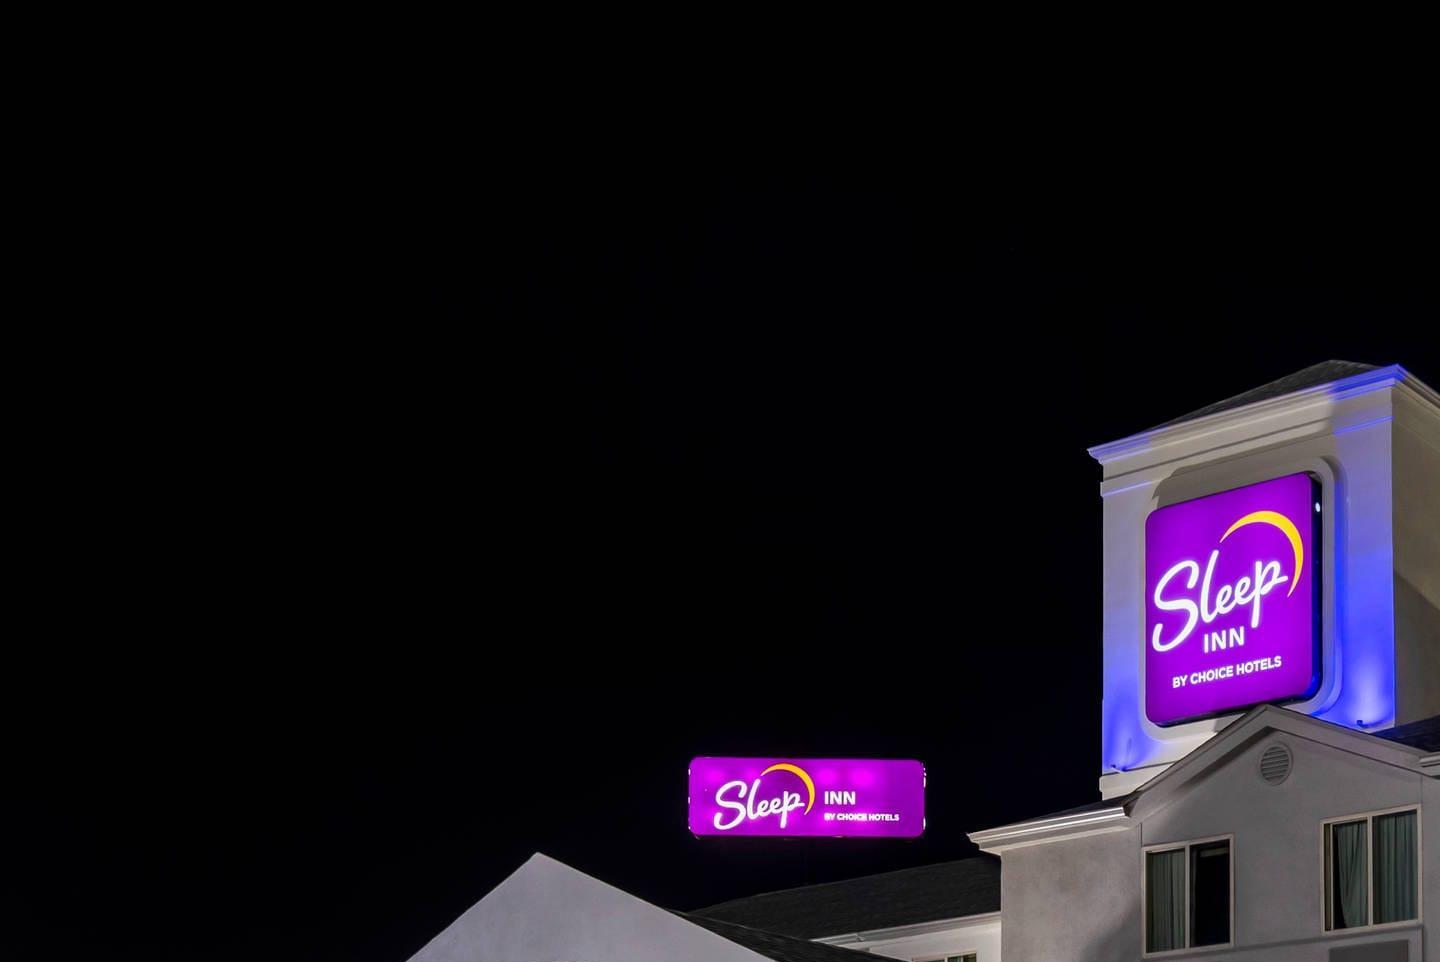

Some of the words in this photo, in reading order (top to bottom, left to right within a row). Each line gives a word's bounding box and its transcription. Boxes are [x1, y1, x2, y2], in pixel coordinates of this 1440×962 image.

[1151, 549, 1289, 652] Sleep
[1203, 626, 1245, 654] INN
[1172, 674, 1189, 689] BY
[1190, 665, 1234, 685] CHOICE
[1236, 655, 1282, 676] HOTELS
[713, 778, 805, 830] Sleep
[824, 790, 856, 805] INN
[824, 813, 836, 821] BY
[836, 813, 867, 822] CHOICE
[868, 813, 900, 822] HOTELS
